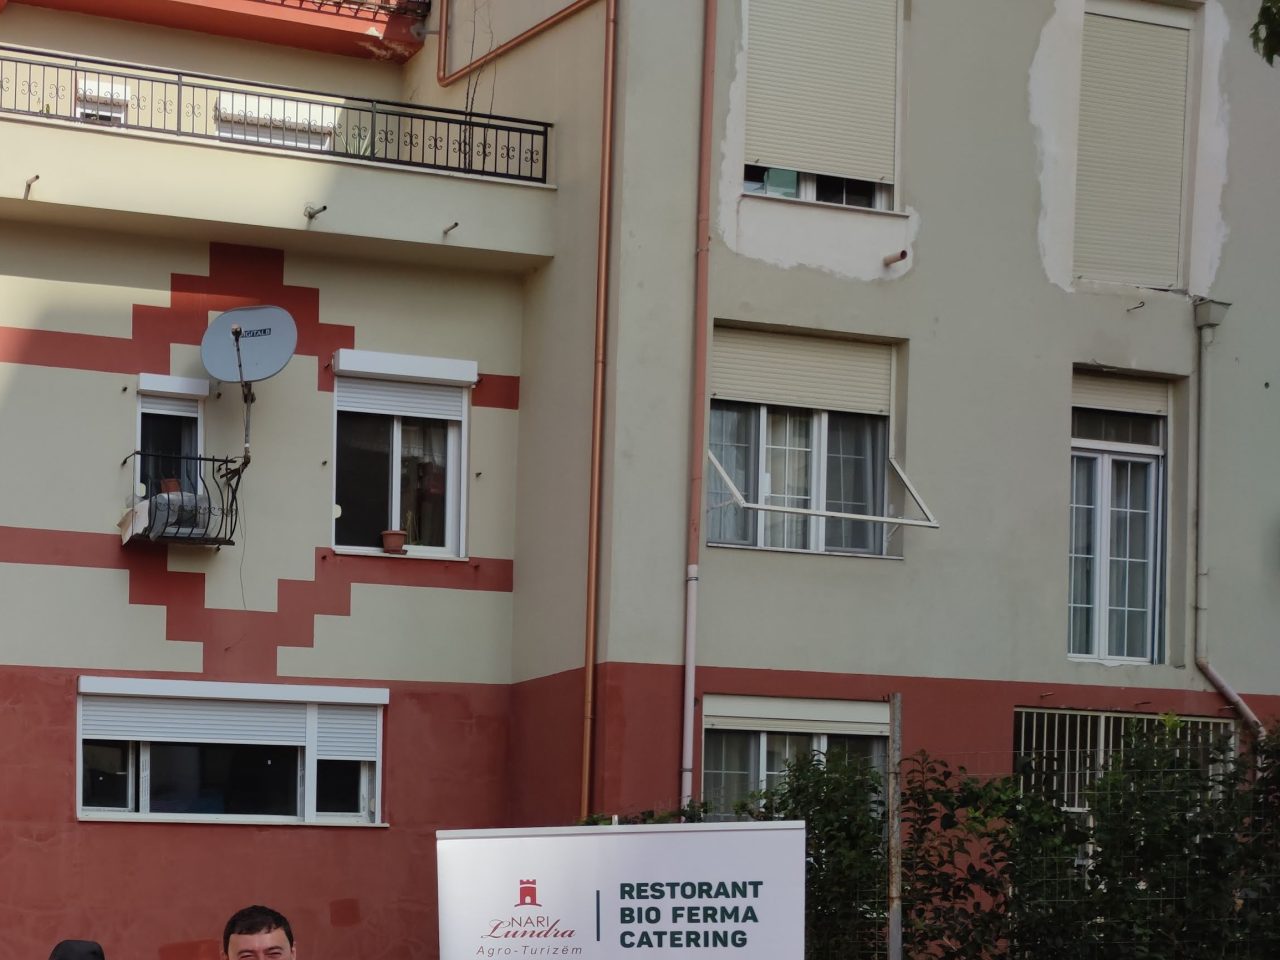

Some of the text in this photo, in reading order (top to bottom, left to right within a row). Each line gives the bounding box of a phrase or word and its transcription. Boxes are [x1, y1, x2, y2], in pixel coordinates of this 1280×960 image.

[619, 880, 763, 900] RESTORANT
[511, 916, 549, 927] NARI
[619, 905, 759, 924] BIO FERMA
[480, 918, 576, 939] Lundra
[619, 930, 748, 949] CATERING
[476, 945, 582, 957] Agro-Turizëm
